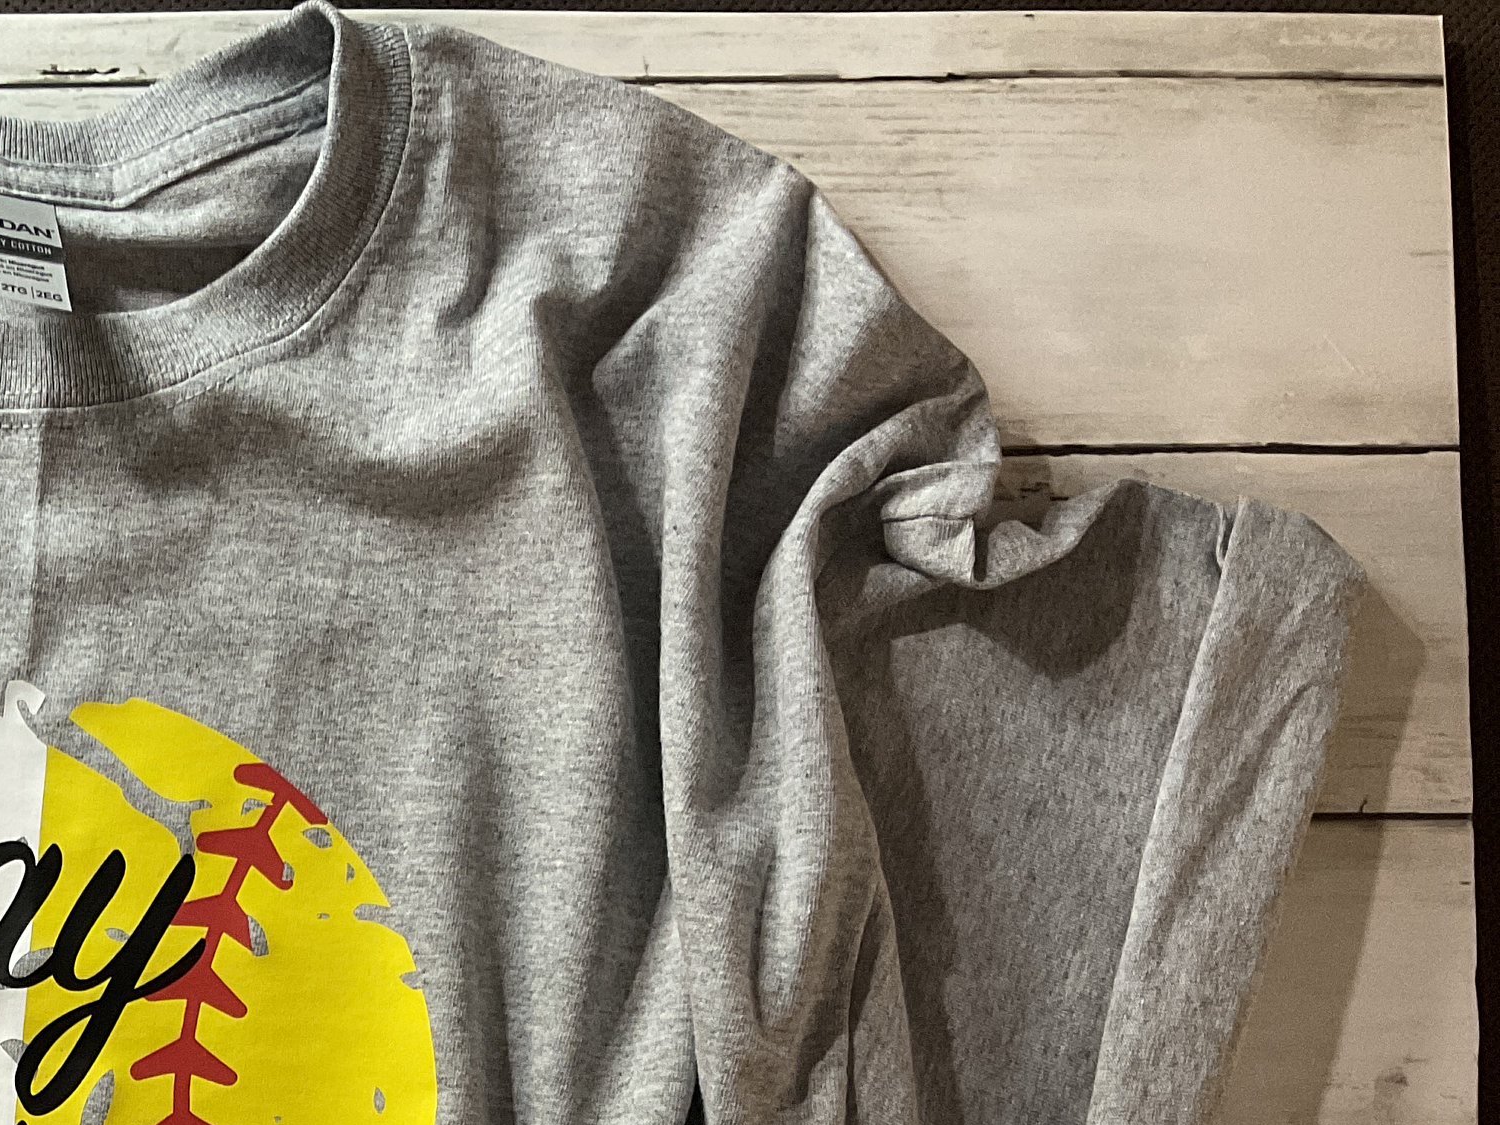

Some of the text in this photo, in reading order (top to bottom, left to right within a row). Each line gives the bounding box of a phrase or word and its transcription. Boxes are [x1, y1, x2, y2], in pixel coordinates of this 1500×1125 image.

[10, 240, 52, 255] COTTON
[1, 283, 28, 295] 2TG
[35, 290, 63, 302] 2EG
